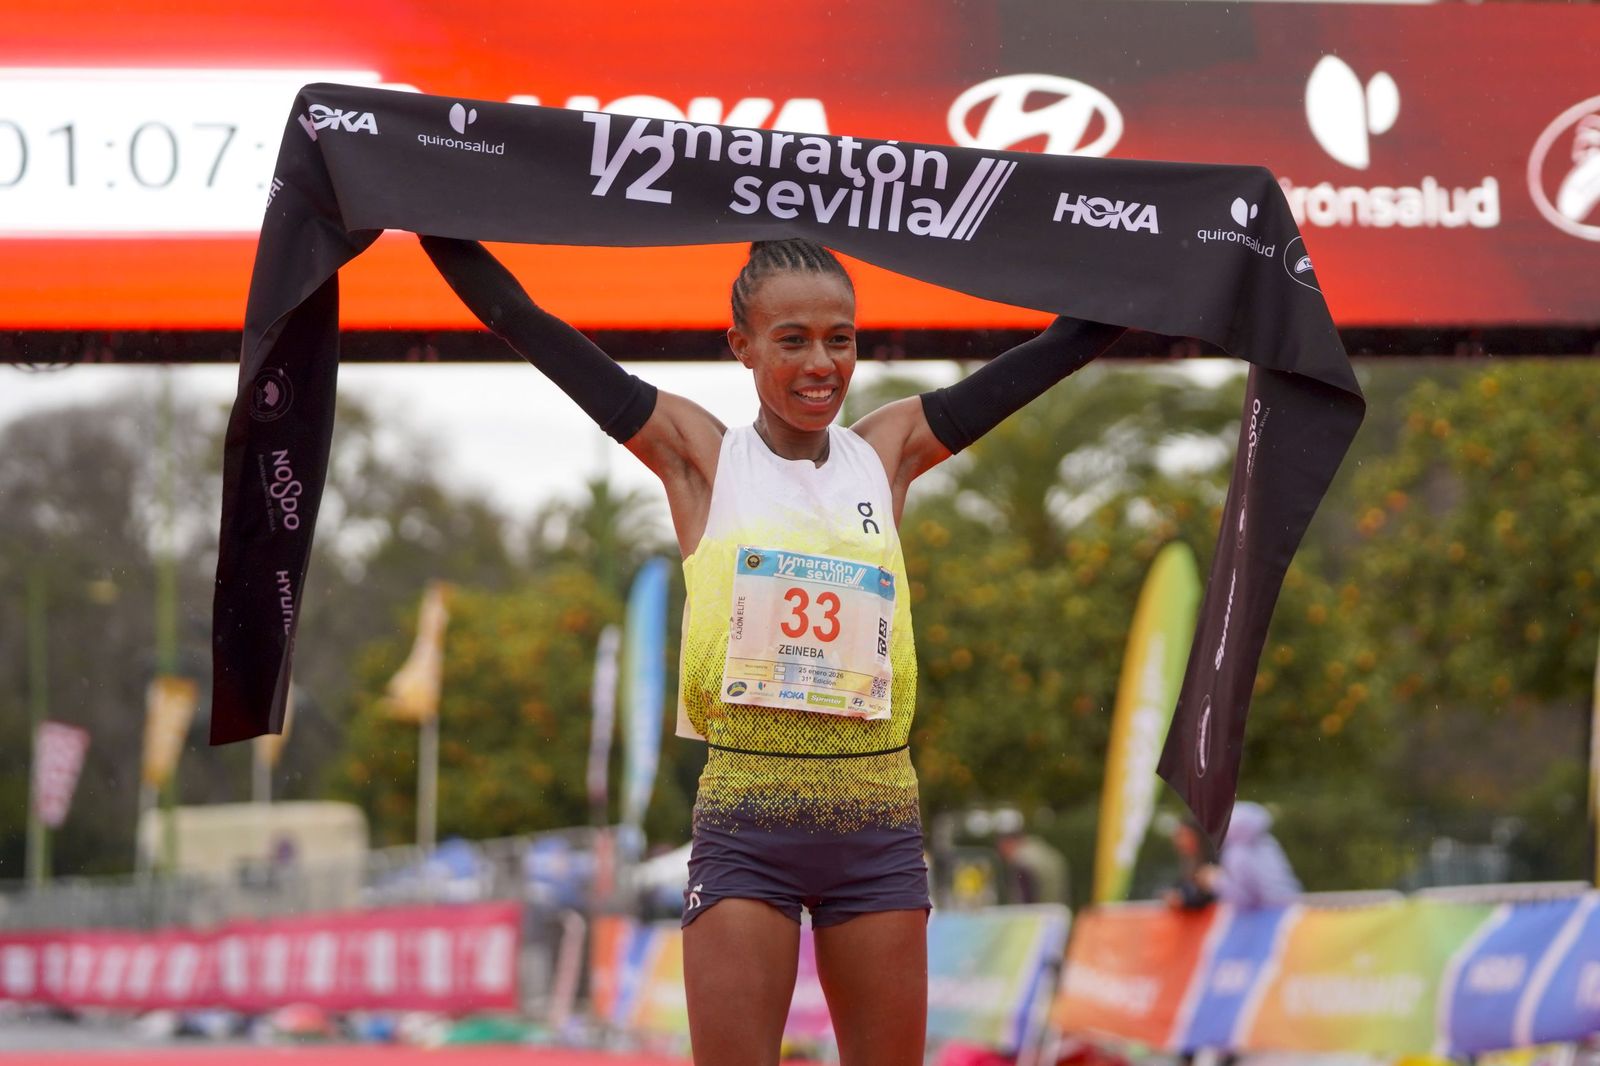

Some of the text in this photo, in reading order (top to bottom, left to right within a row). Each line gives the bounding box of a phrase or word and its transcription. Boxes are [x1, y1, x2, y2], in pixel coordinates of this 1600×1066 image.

[663, 119, 949, 190] maratón
[729, 173, 952, 239] sevilla
[1278, 176, 1499, 228] rónsalud
[1053, 192, 1159, 234] HOKA
[793, 557, 853, 574] maratón
[806, 569, 854, 585] sevilla
[780, 587, 841, 642] 33
[778, 644, 824, 659] ZEINEBA
[808, 669, 828, 677] enero
[828, 671, 844, 679] 2026
[778, 690, 805, 700] HOKA
[811, 694, 841, 705] Sprinter
